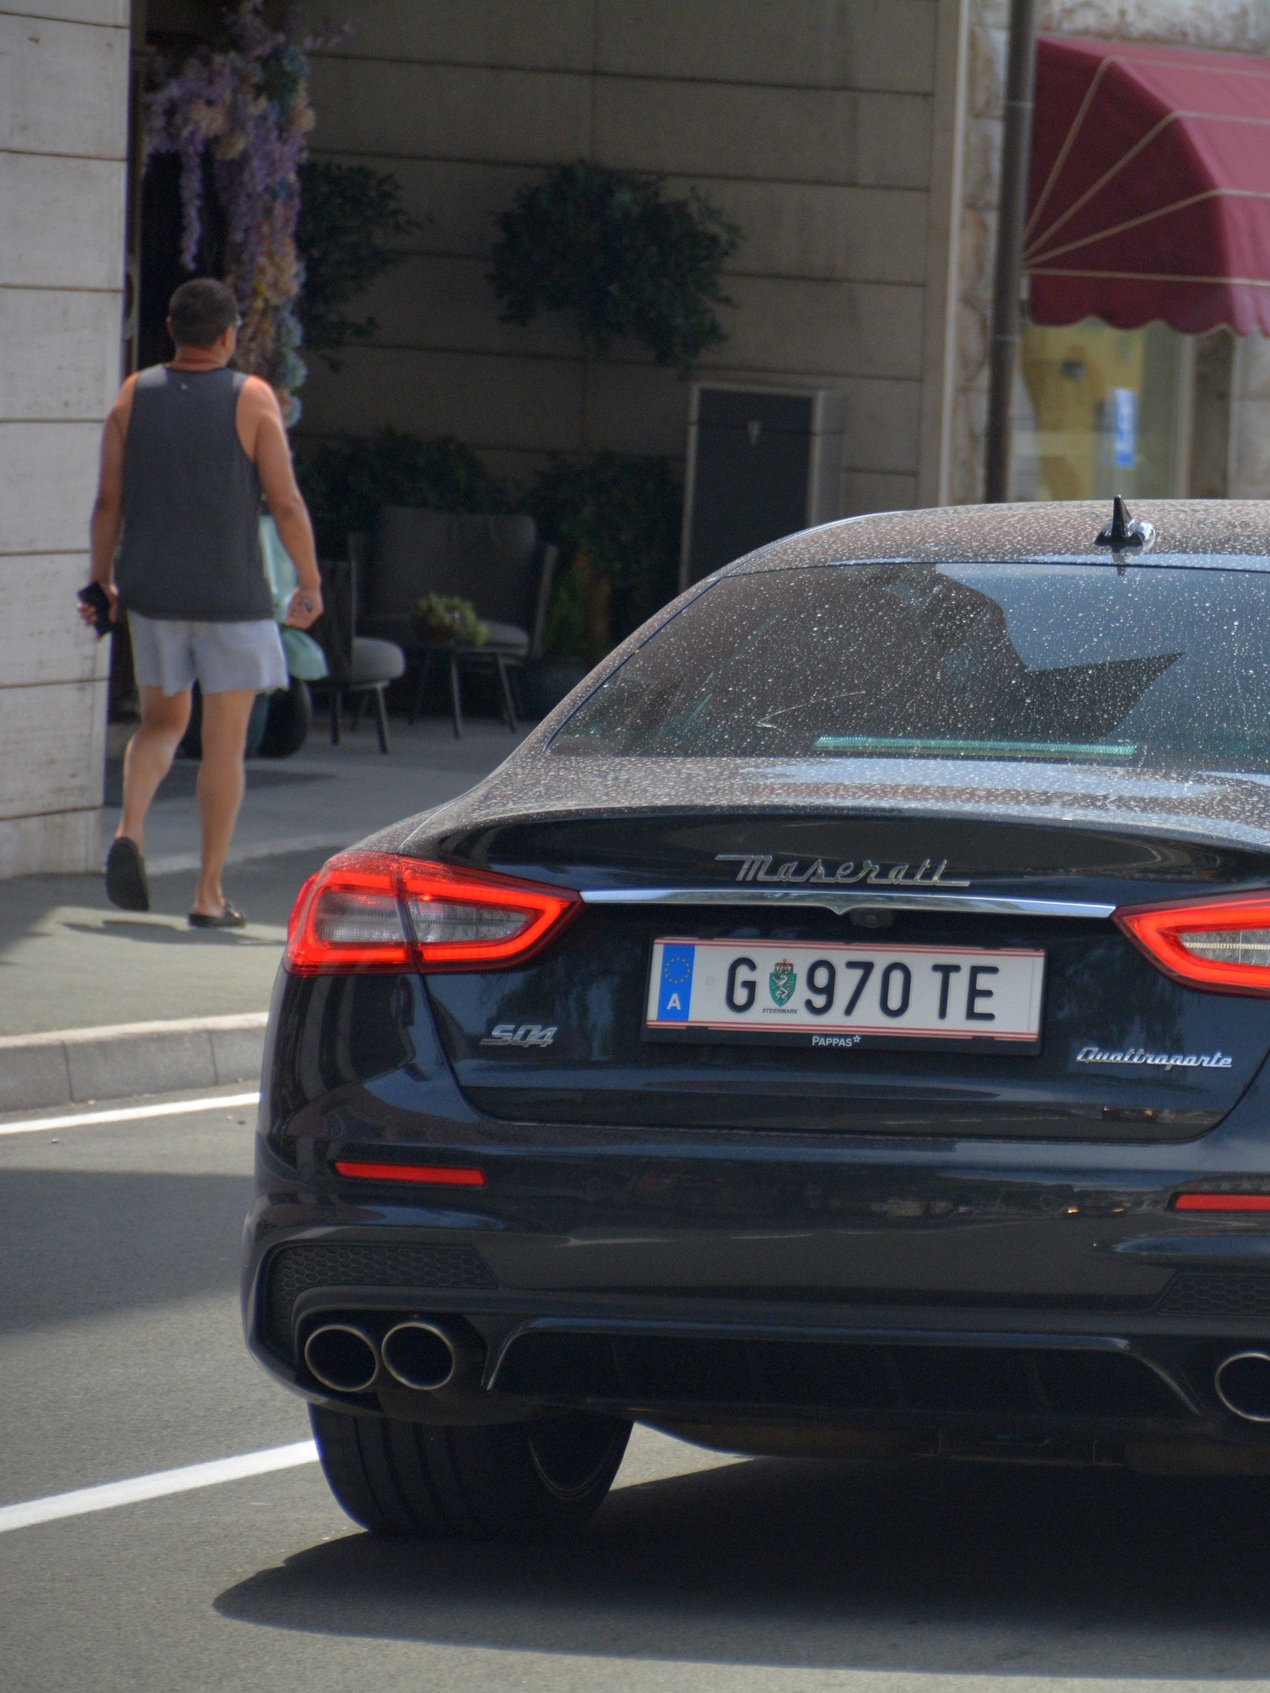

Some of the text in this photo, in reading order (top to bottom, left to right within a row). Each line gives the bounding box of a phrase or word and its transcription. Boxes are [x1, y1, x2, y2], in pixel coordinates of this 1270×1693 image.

[714, 854, 971, 887] Maserati
[725, 956, 1000, 1021] G 970 TE
[666, 993, 682, 1011] A
[761, 1007, 798, 1015] STEIERMARK
[1076, 1047, 1233, 1071] Quattroporte
